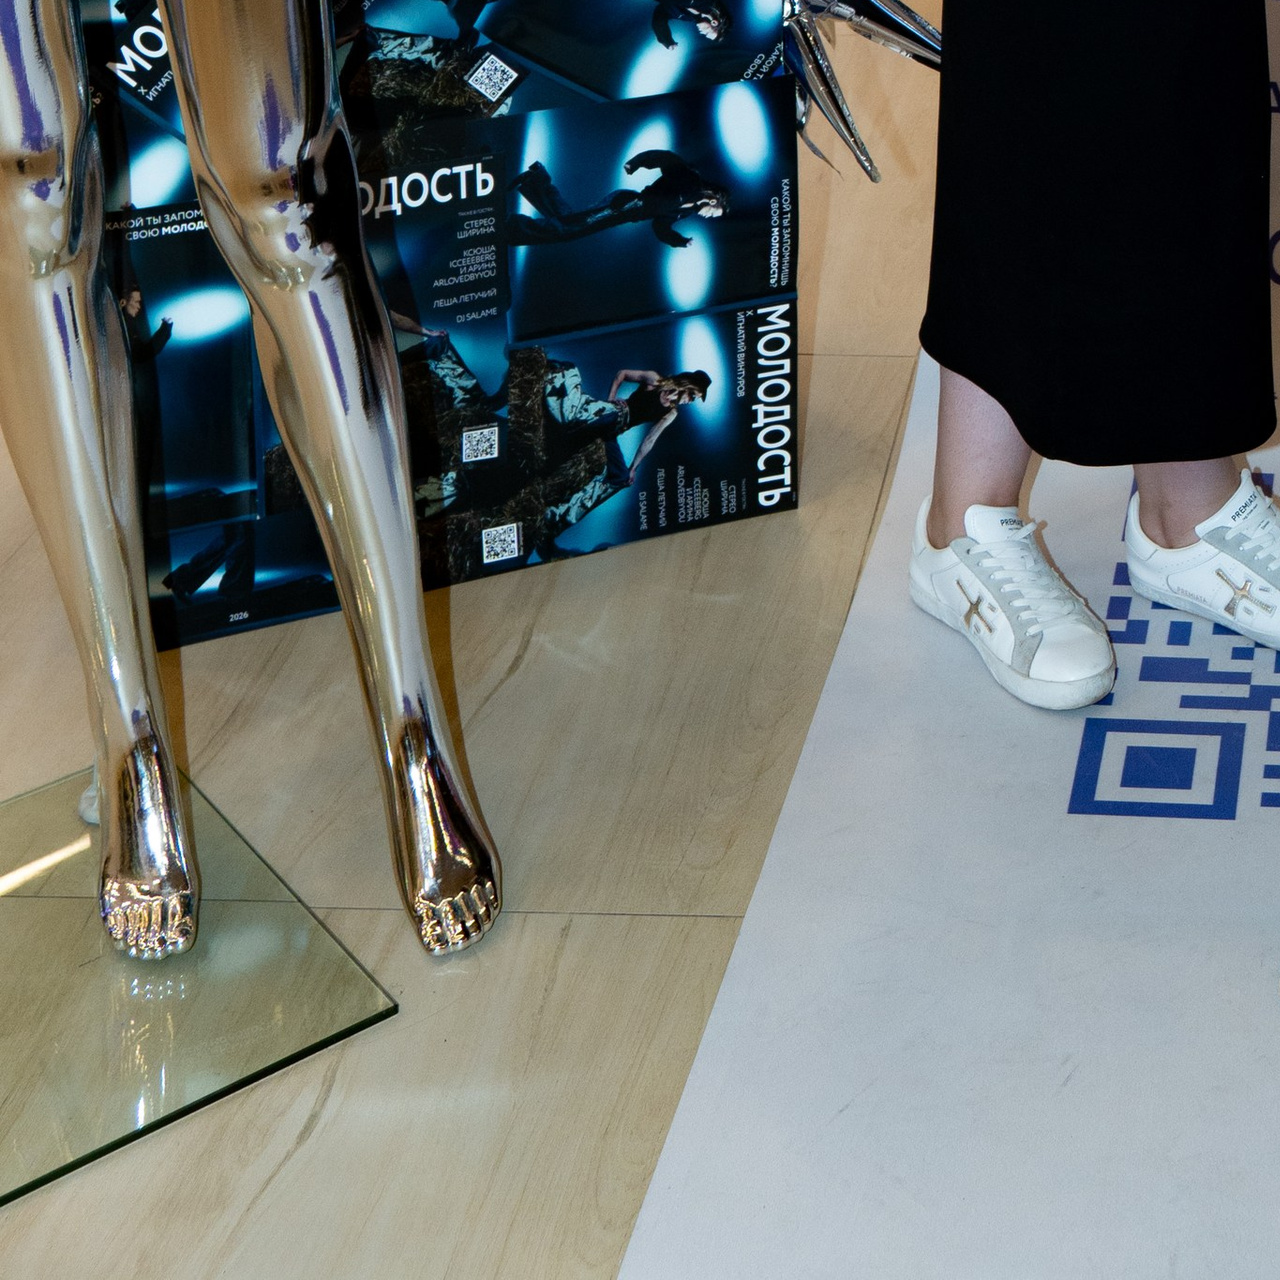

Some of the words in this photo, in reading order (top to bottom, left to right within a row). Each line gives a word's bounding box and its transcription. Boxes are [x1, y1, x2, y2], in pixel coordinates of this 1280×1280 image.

[743, 53, 765, 79] СВОЮ
[782, 179, 791, 213] КАКОЙ
[105, 217, 143, 231] КАКОЙ
[145, 215, 162, 226] ТЫ
[163, 208, 203, 223] ЗАПОМ
[770, 197, 779, 226] СВОЮ
[783, 213, 791, 227] ТЫ
[457, 226, 495, 239] ШИРИНА
[464, 217, 495, 230] СТЕРЕО
[125, 228, 160, 241] СВОЮ
[463, 245, 496, 257] КСЮША
[769, 227, 779, 289] МОЛОДОСТЬ?
[780, 228, 791, 287] ЗАПОМНИШЬ
[468, 261, 496, 273] АРИНА
[459, 288, 497, 304] ЛЕТУЧИЙ
[467, 307, 497, 321] SALAME
[737, 312, 745, 353] ИГНАТИЙ
[737, 354, 746, 397] ВИНТУРОВ
[752, 304, 792, 507] МОЛОДОСТЬ
[229, 611, 249, 622] 2026
